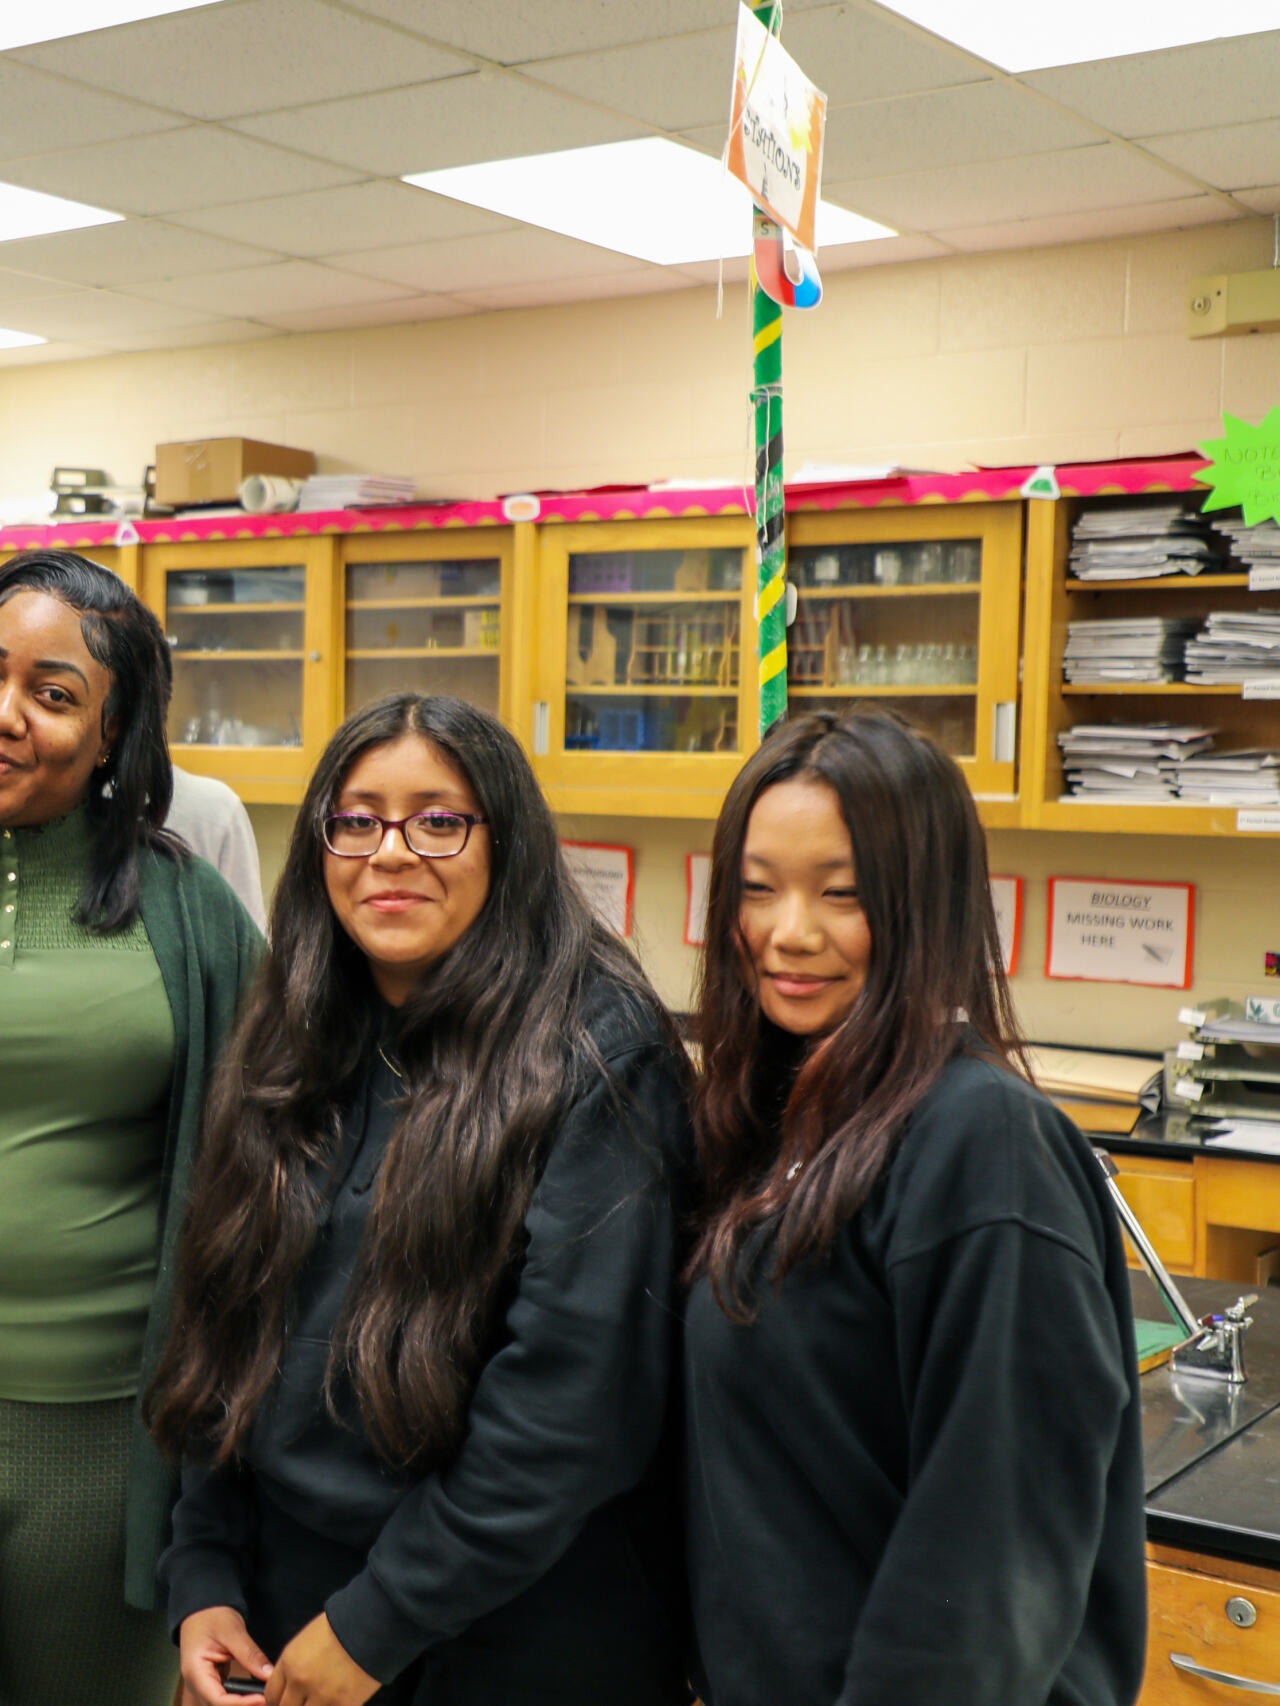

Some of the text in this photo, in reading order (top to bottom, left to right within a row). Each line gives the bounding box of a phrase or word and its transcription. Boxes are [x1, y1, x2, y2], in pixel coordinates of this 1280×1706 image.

[1090, 892, 1152, 910] BIOLOGY
[1066, 911, 1175, 932] MISSING WORK
[1080, 934, 1116, 948] HERE
